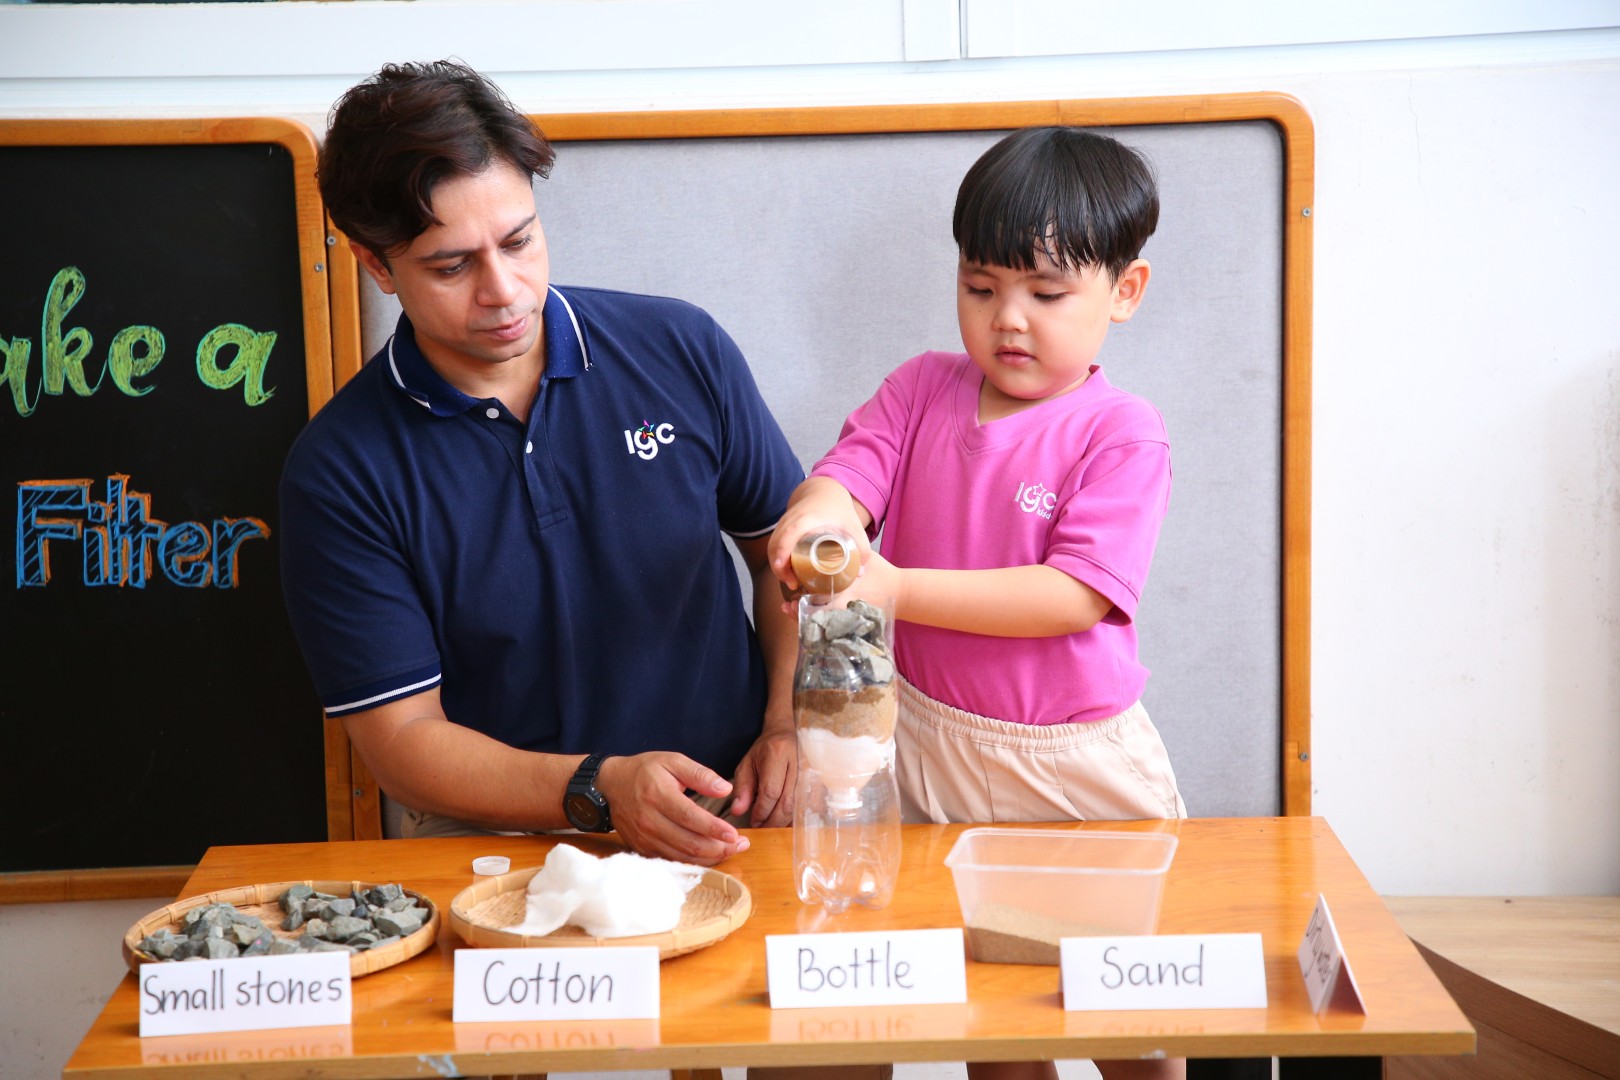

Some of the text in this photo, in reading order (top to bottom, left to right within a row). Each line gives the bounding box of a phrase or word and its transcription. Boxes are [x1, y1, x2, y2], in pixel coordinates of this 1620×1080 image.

[196, 322, 278, 406] a
[16, 472, 271, 589] Filter
[483, 960, 614, 1006] Cotton
[797, 940, 914, 992] Bottle
[1100, 943, 1204, 989] Sand
[143, 968, 343, 1015] Small stones
